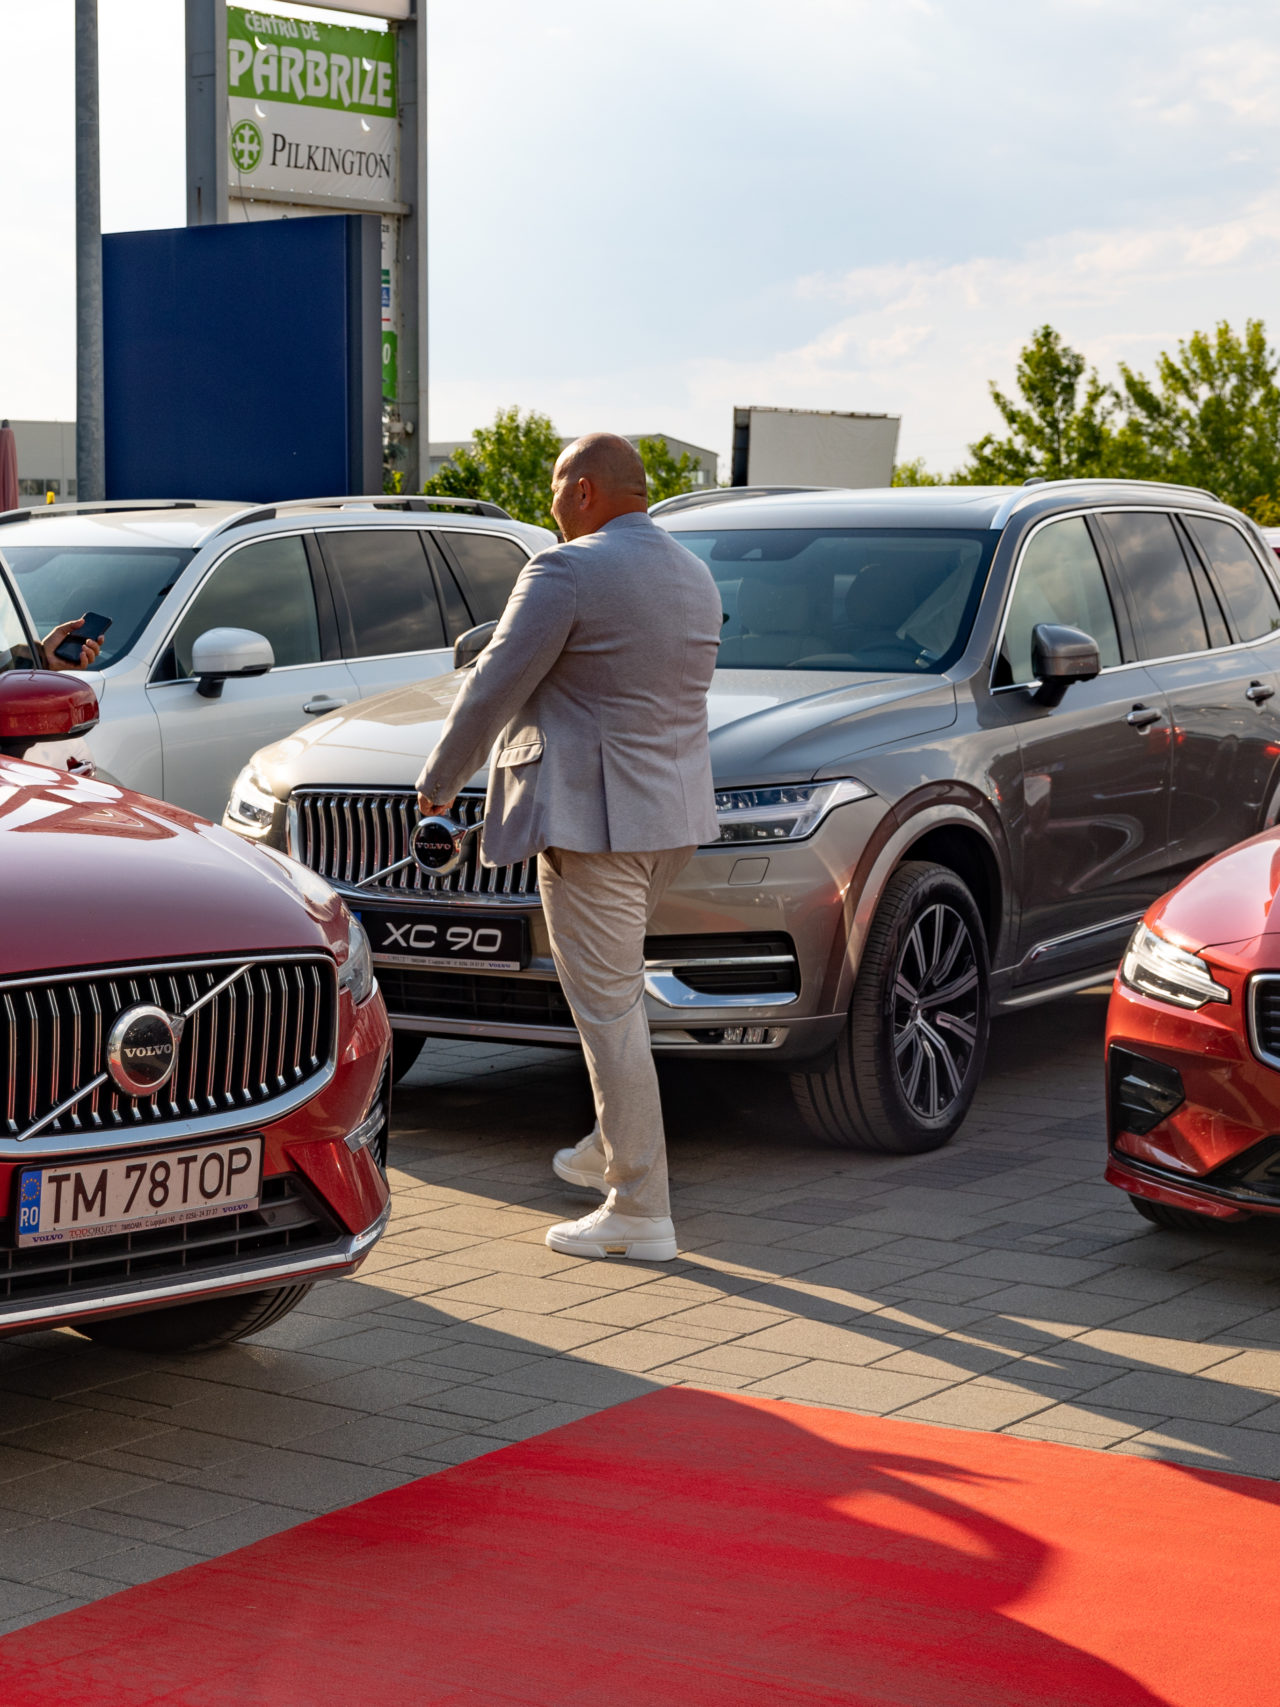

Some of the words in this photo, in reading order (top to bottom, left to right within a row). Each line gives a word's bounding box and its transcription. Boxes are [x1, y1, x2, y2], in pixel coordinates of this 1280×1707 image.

[245, 13, 298, 39] CENTRU
[300, 22, 320, 41] DE
[228, 38, 393, 108] PARBRIZE
[270, 132, 392, 179] PILKINGTON
[415, 841, 451, 850] VOLVO
[381, 922, 437, 949] XC
[445, 926, 502, 953] 90
[123, 1043, 172, 1058] VOLVO
[48, 1169, 108, 1223] TM
[20, 1207, 39, 1227] RO
[32, 1234, 63, 1242] VOLVO
[222, 1203, 248, 1213] VOLVO
